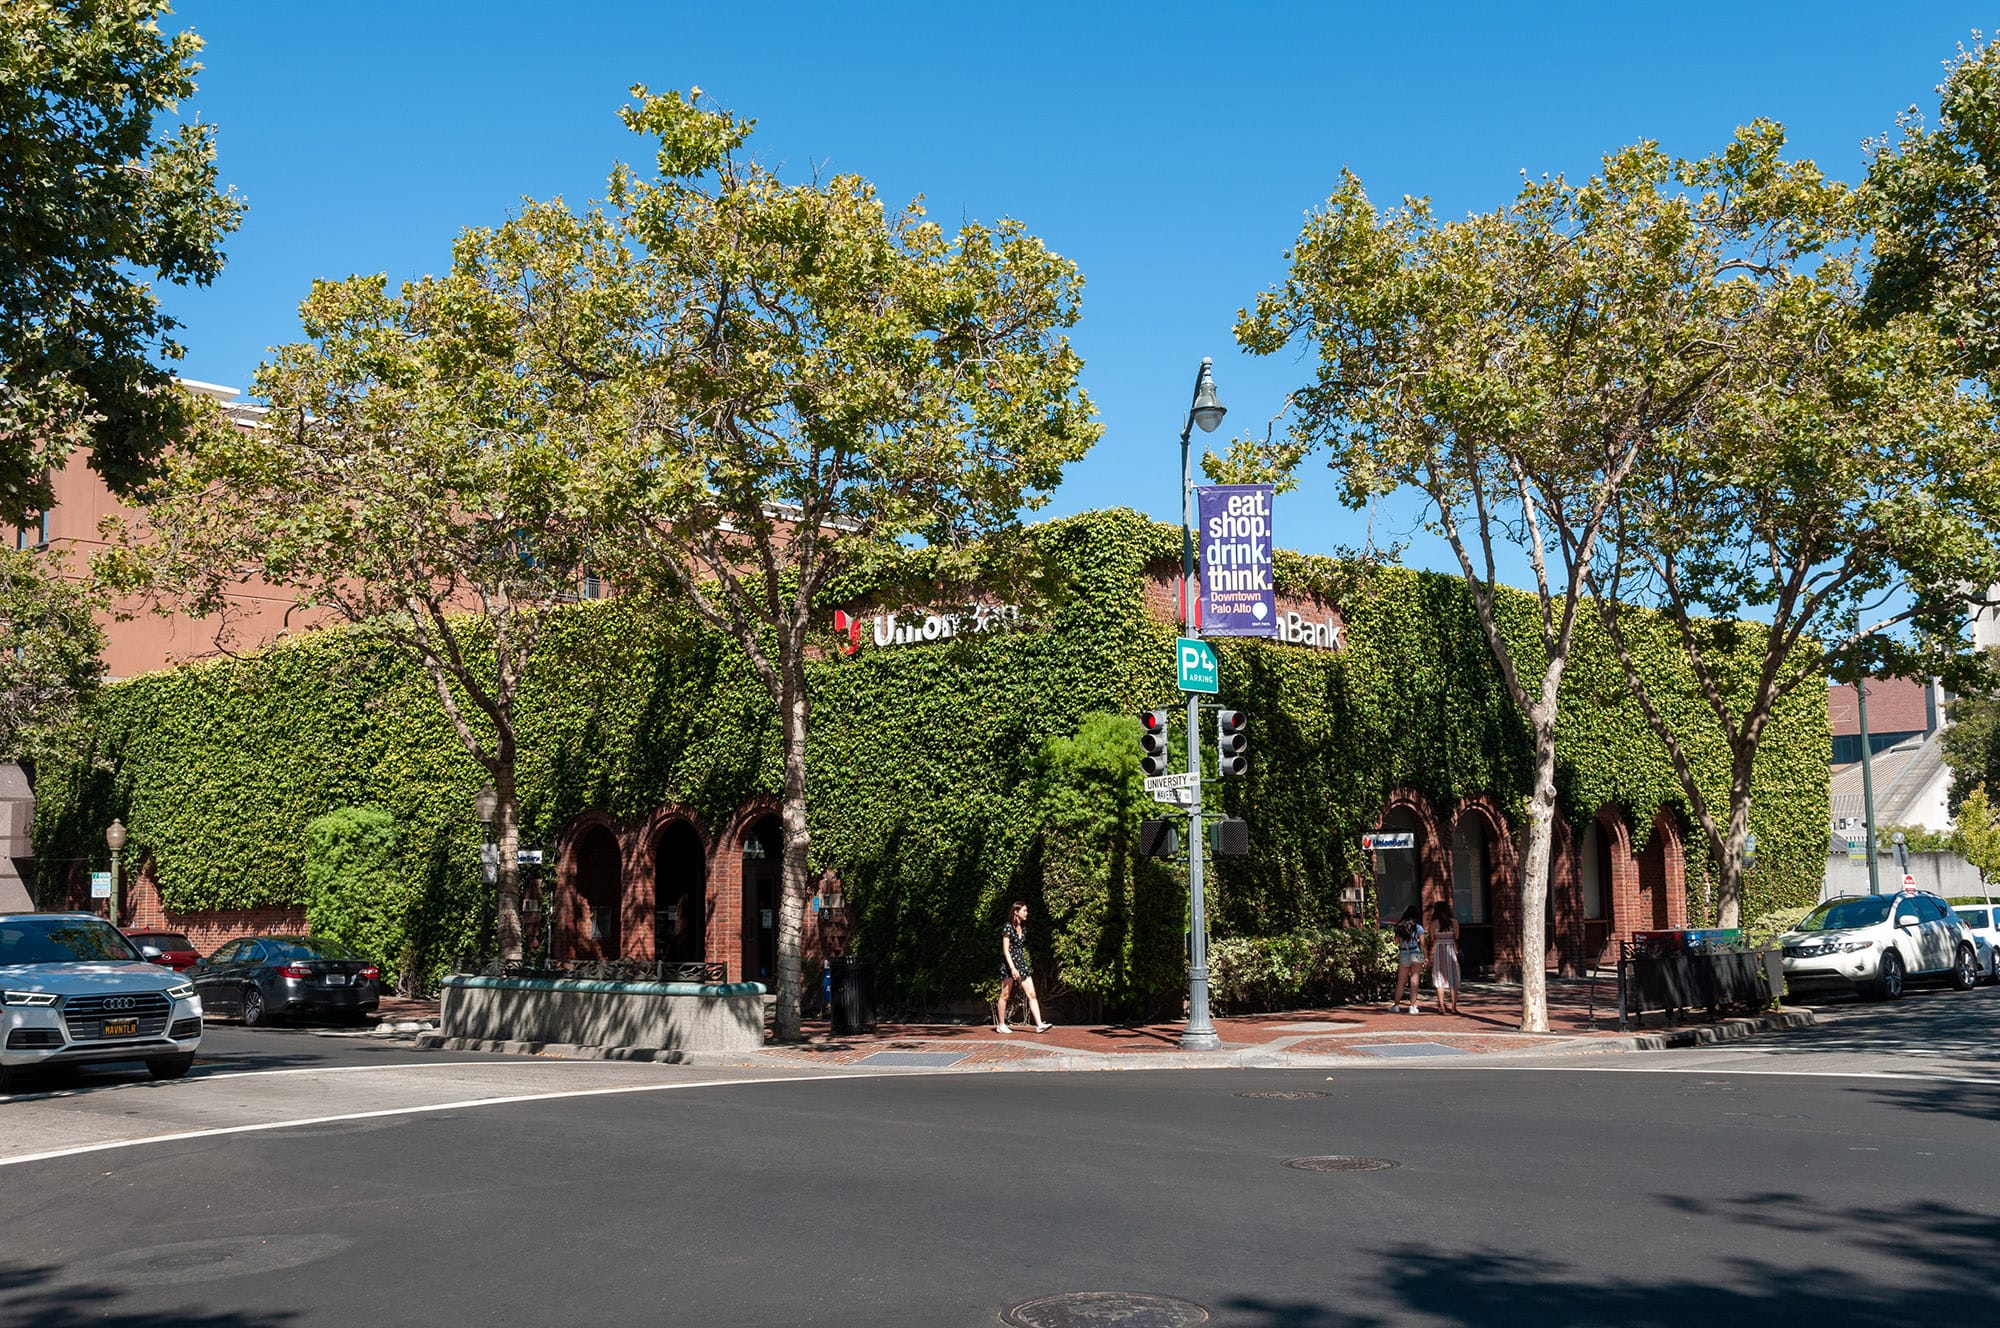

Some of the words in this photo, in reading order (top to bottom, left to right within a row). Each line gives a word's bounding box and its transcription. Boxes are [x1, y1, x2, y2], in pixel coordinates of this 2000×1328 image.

[1228, 490, 1270, 516] eat.
[1209, 511, 1271, 539] shop.
[1206, 538, 1272, 566] drink.
[1208, 565, 1273, 592] think.
[1210, 591, 1261, 602] Downtown
[1211, 603, 1232, 614] Palo
[1233, 603, 1252, 614] Alto
[1147, 775, 1187, 790] UNIVERSITY
